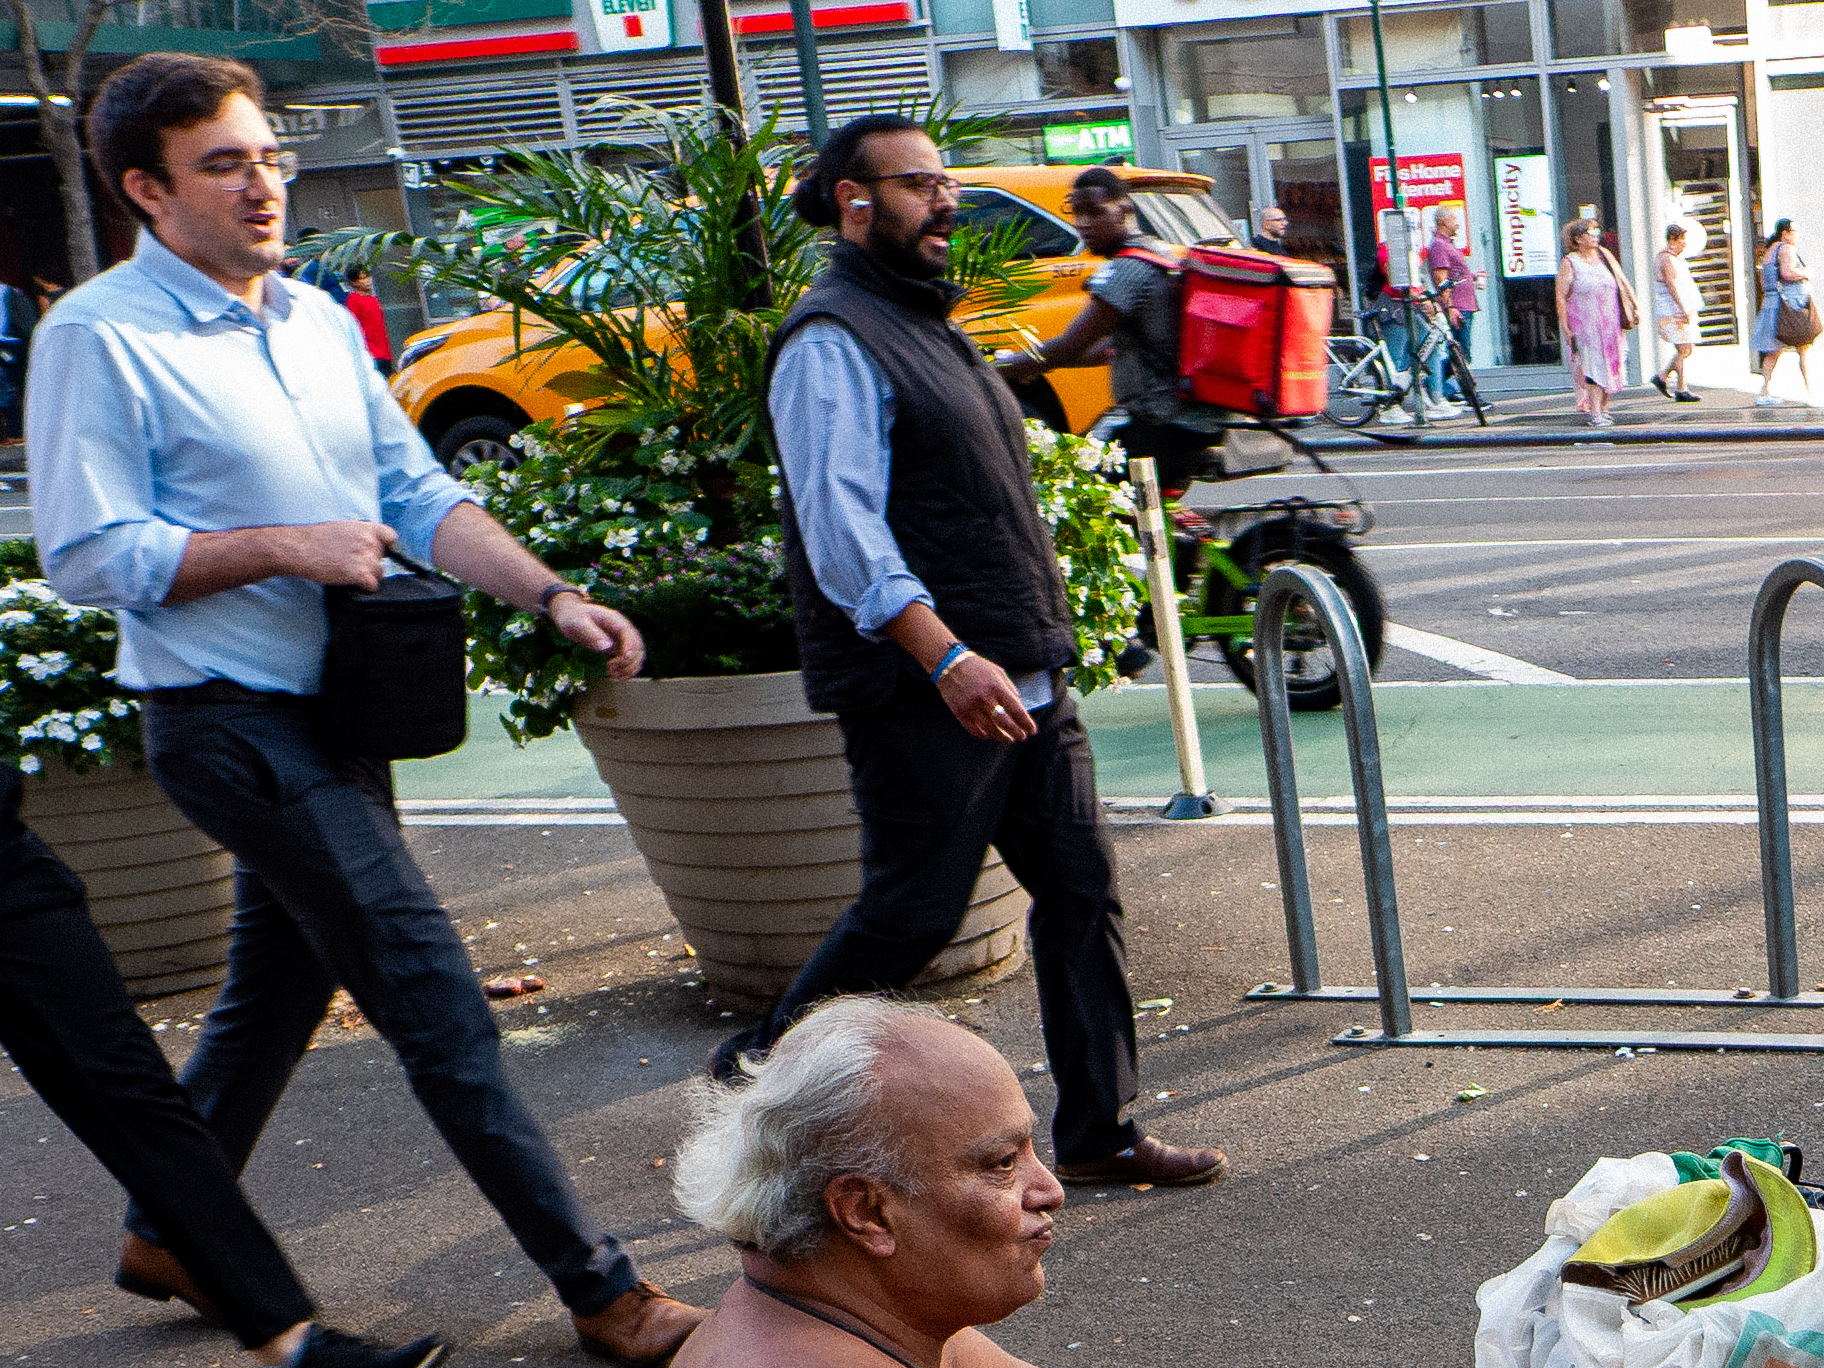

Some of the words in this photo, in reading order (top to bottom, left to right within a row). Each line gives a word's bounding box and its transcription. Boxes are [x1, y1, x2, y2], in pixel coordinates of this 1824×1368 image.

[1078, 125, 1132, 151] ATM
[1374, 166, 1410, 182] Fis
[1410, 163, 1462, 180] Home
[1385, 179, 1453, 199] Iternet
[1502, 163, 1526, 273] Simplicity
